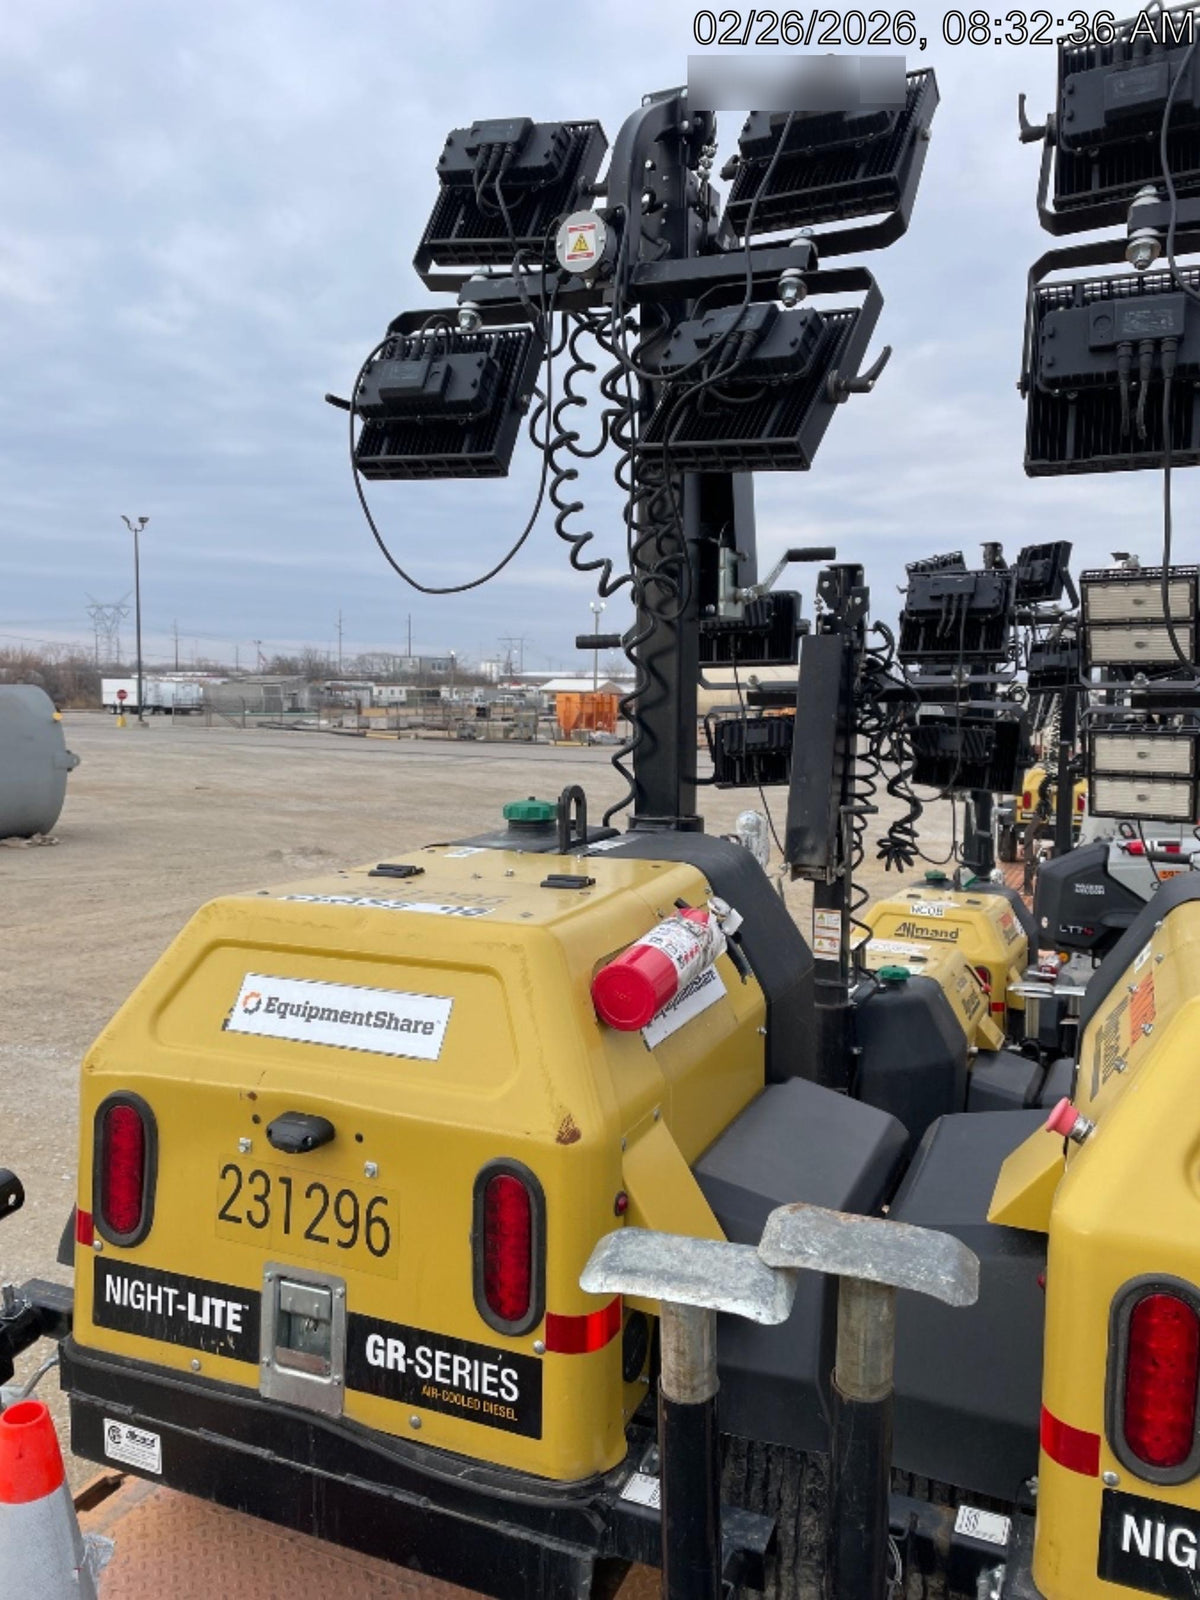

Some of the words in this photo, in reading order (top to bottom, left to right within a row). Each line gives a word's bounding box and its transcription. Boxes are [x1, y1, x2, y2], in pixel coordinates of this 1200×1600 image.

[894, 922, 959, 941] Allmand
[262, 996, 435, 1036] EquipmentShare
[218, 1163, 391, 1258] 231296
[365, 1332, 520, 1402] GR-SERIES
[421, 1384, 481, 1411] AIR-COOLED
[483, 1401, 519, 1422] DIESEL
[1121, 1513, 1198, 1571] NIG
